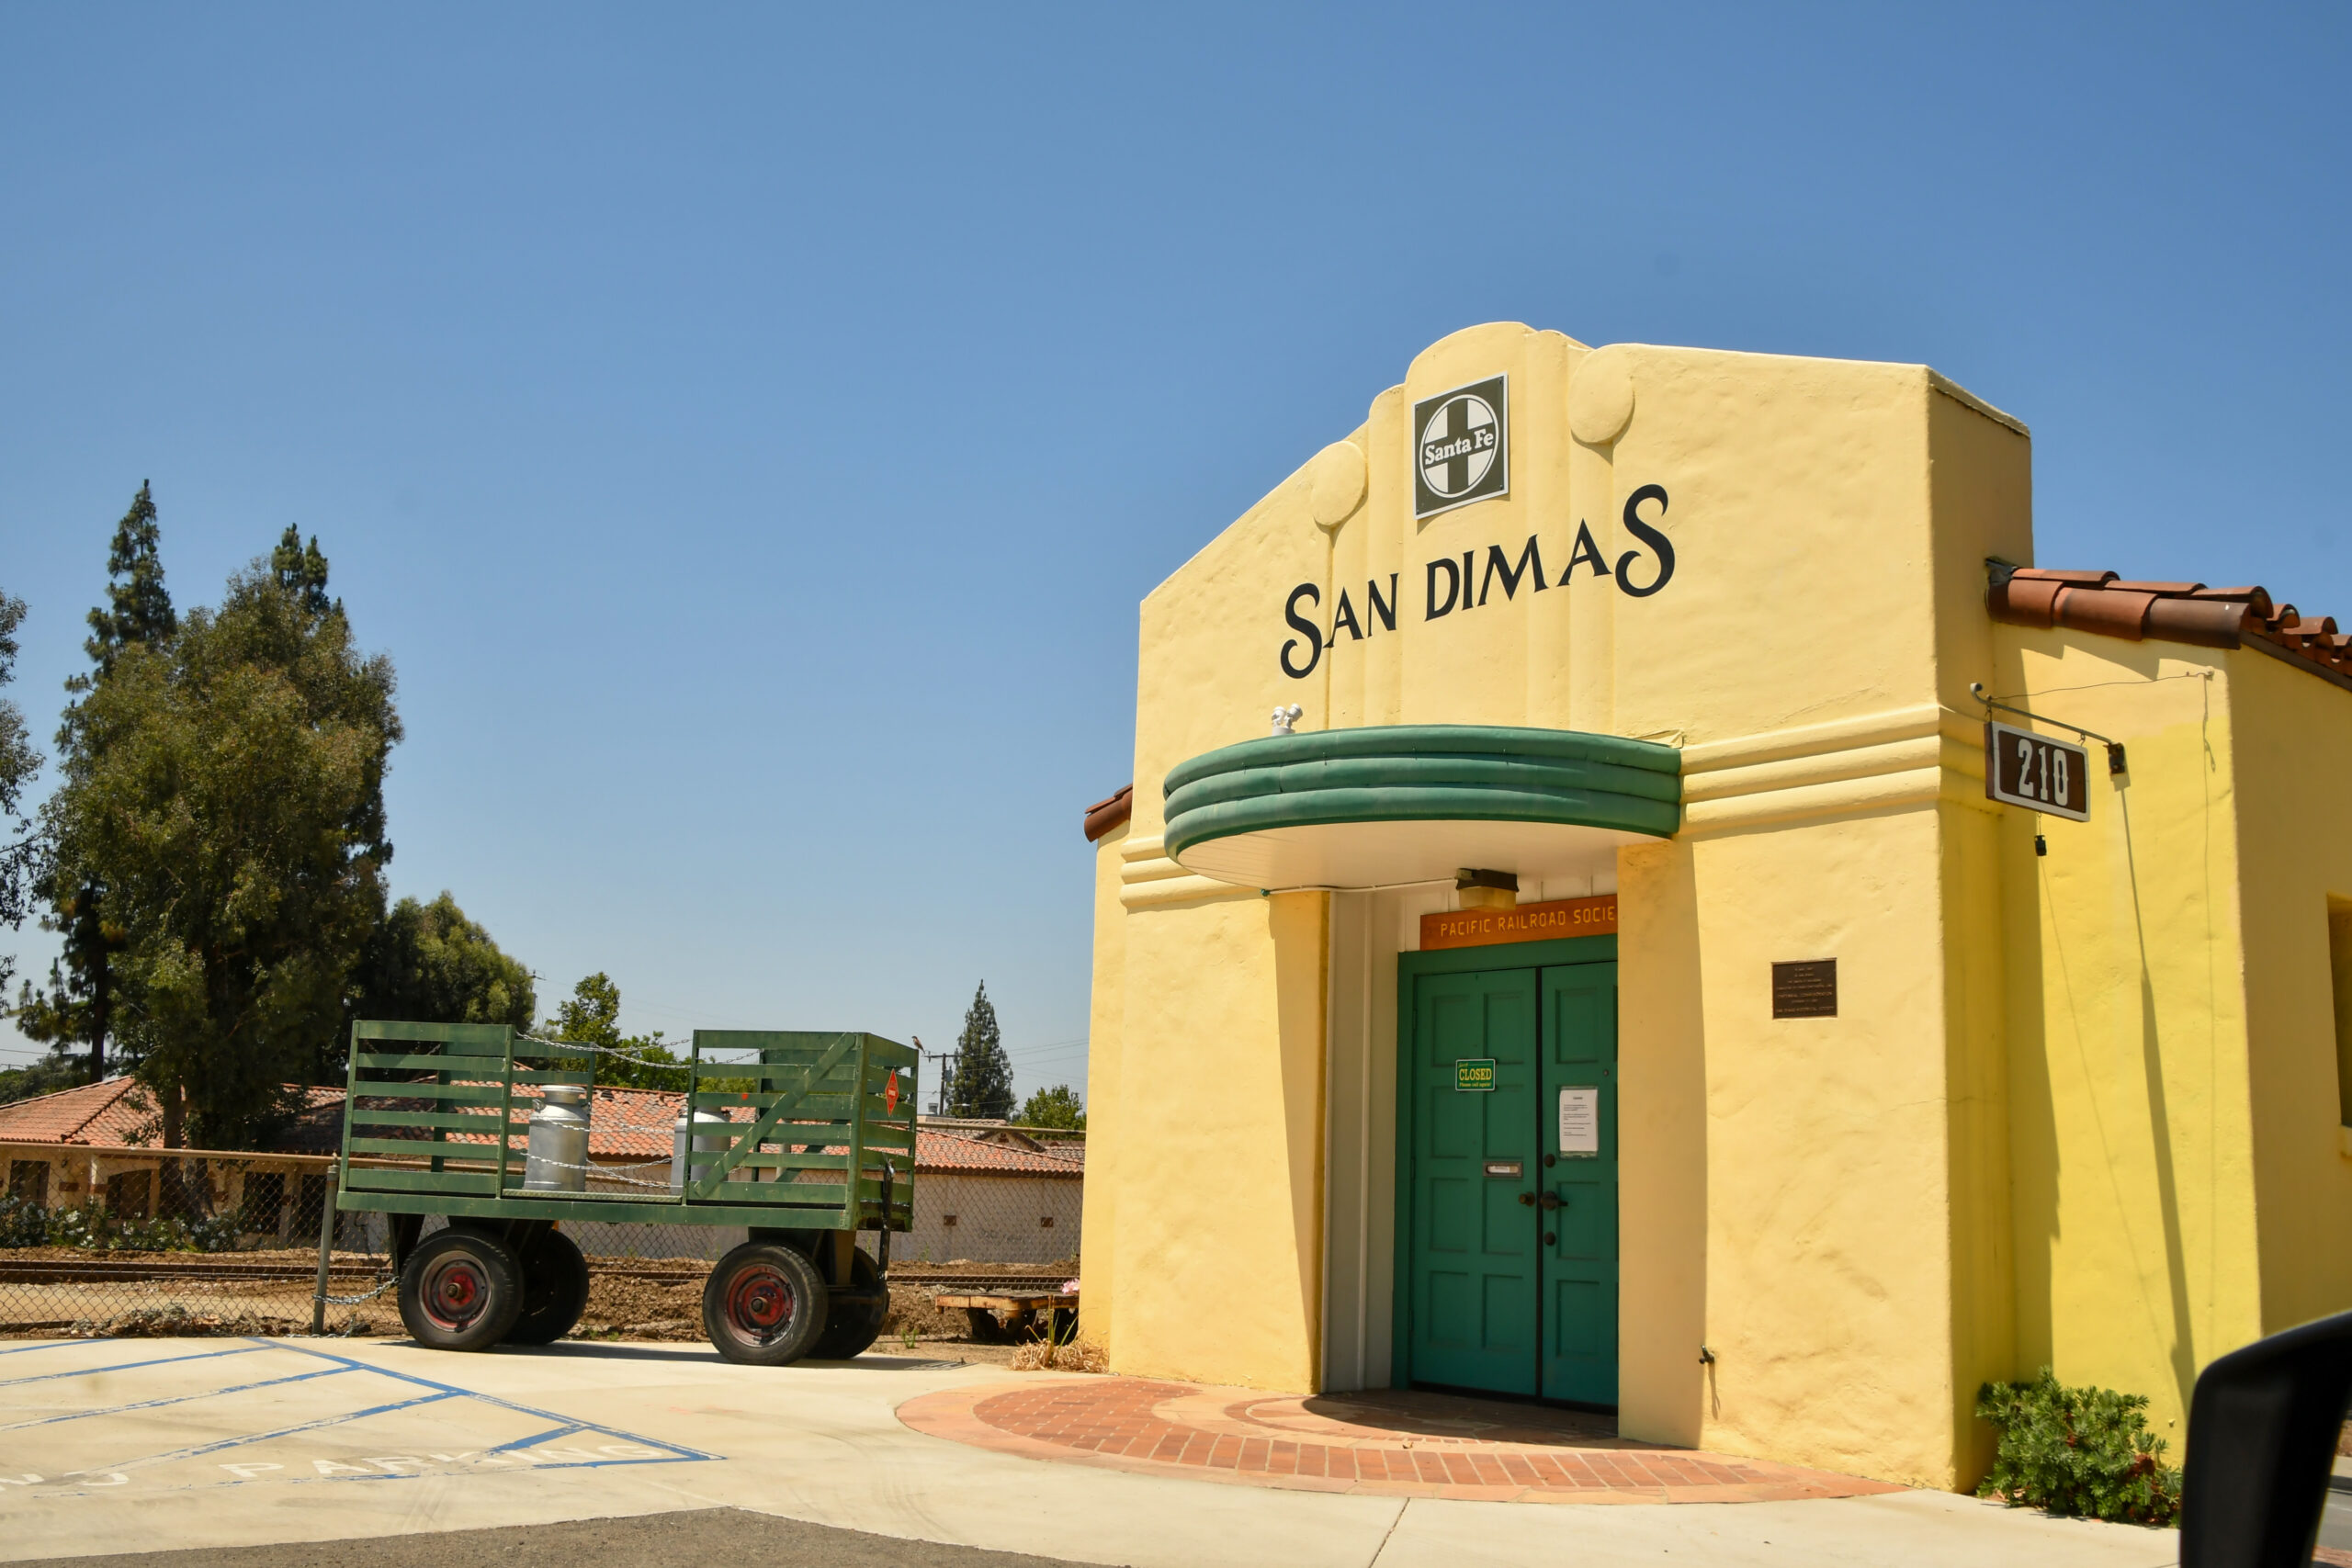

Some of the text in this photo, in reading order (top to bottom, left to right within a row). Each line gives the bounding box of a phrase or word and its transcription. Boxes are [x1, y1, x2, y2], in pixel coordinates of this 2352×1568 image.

[1425, 428, 1494, 465] Santa Fe
[1280, 483, 1676, 680] SAN DIMAS
[2018, 738, 2069, 807] 210
[1441, 906, 1616, 937] PACIFIC RAILROAD SOCIE
[1459, 1067, 1492, 1081] CLOSED
